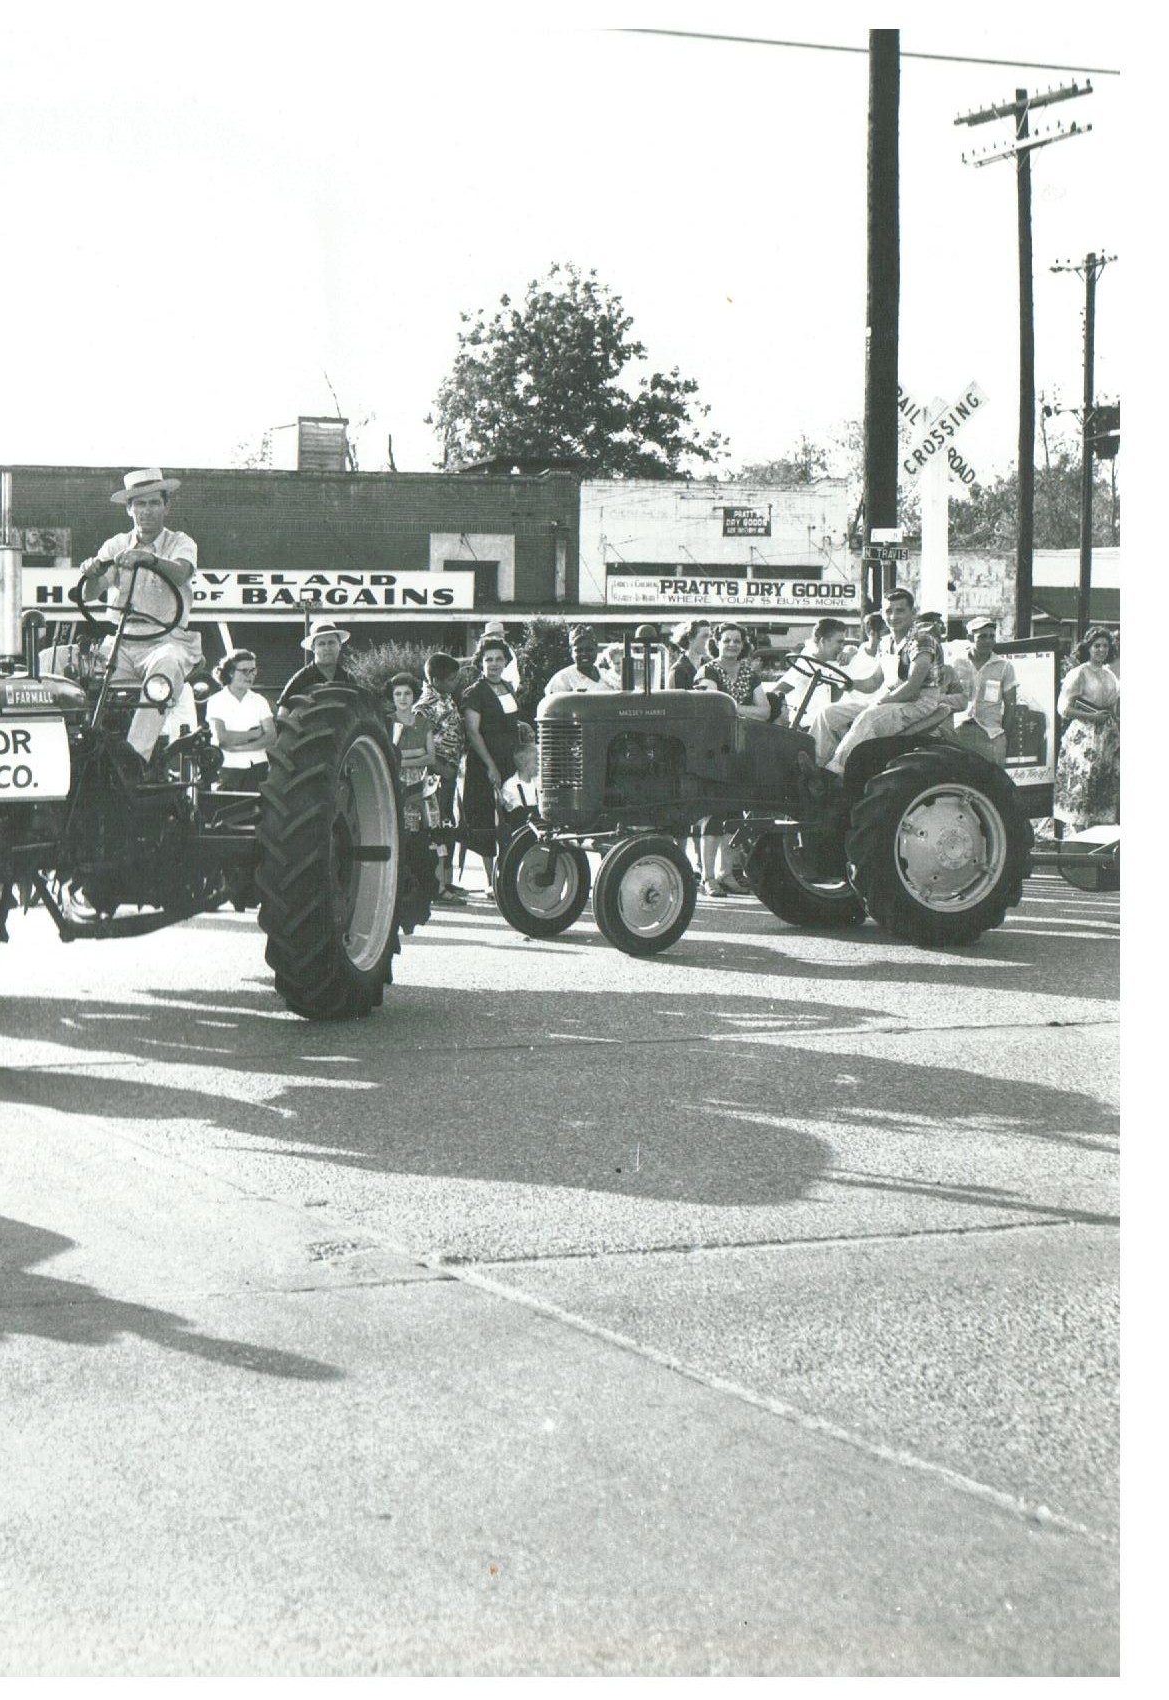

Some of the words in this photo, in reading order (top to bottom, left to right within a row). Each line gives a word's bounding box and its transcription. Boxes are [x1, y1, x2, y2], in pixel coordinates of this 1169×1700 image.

[904, 393, 983, 475] CROSSING
[948, 447, 976, 485] ROAD
[726, 518, 741, 526] DRY
[865, 547, 871, 558] N
[877, 548, 907, 560] TRAVIS
[659, 579, 740, 596] PRATT'S
[746, 581, 785, 597] DRY
[792, 583, 856, 598] GOODS
[193, 590, 224, 600] OF
[242, 588, 454, 605] BARGAINS
[719, 596, 755, 604] YOUR
[763, 596, 771, 605] $
[777, 597, 810, 605] BUYS
[15, 691, 53, 704] FARMALL
